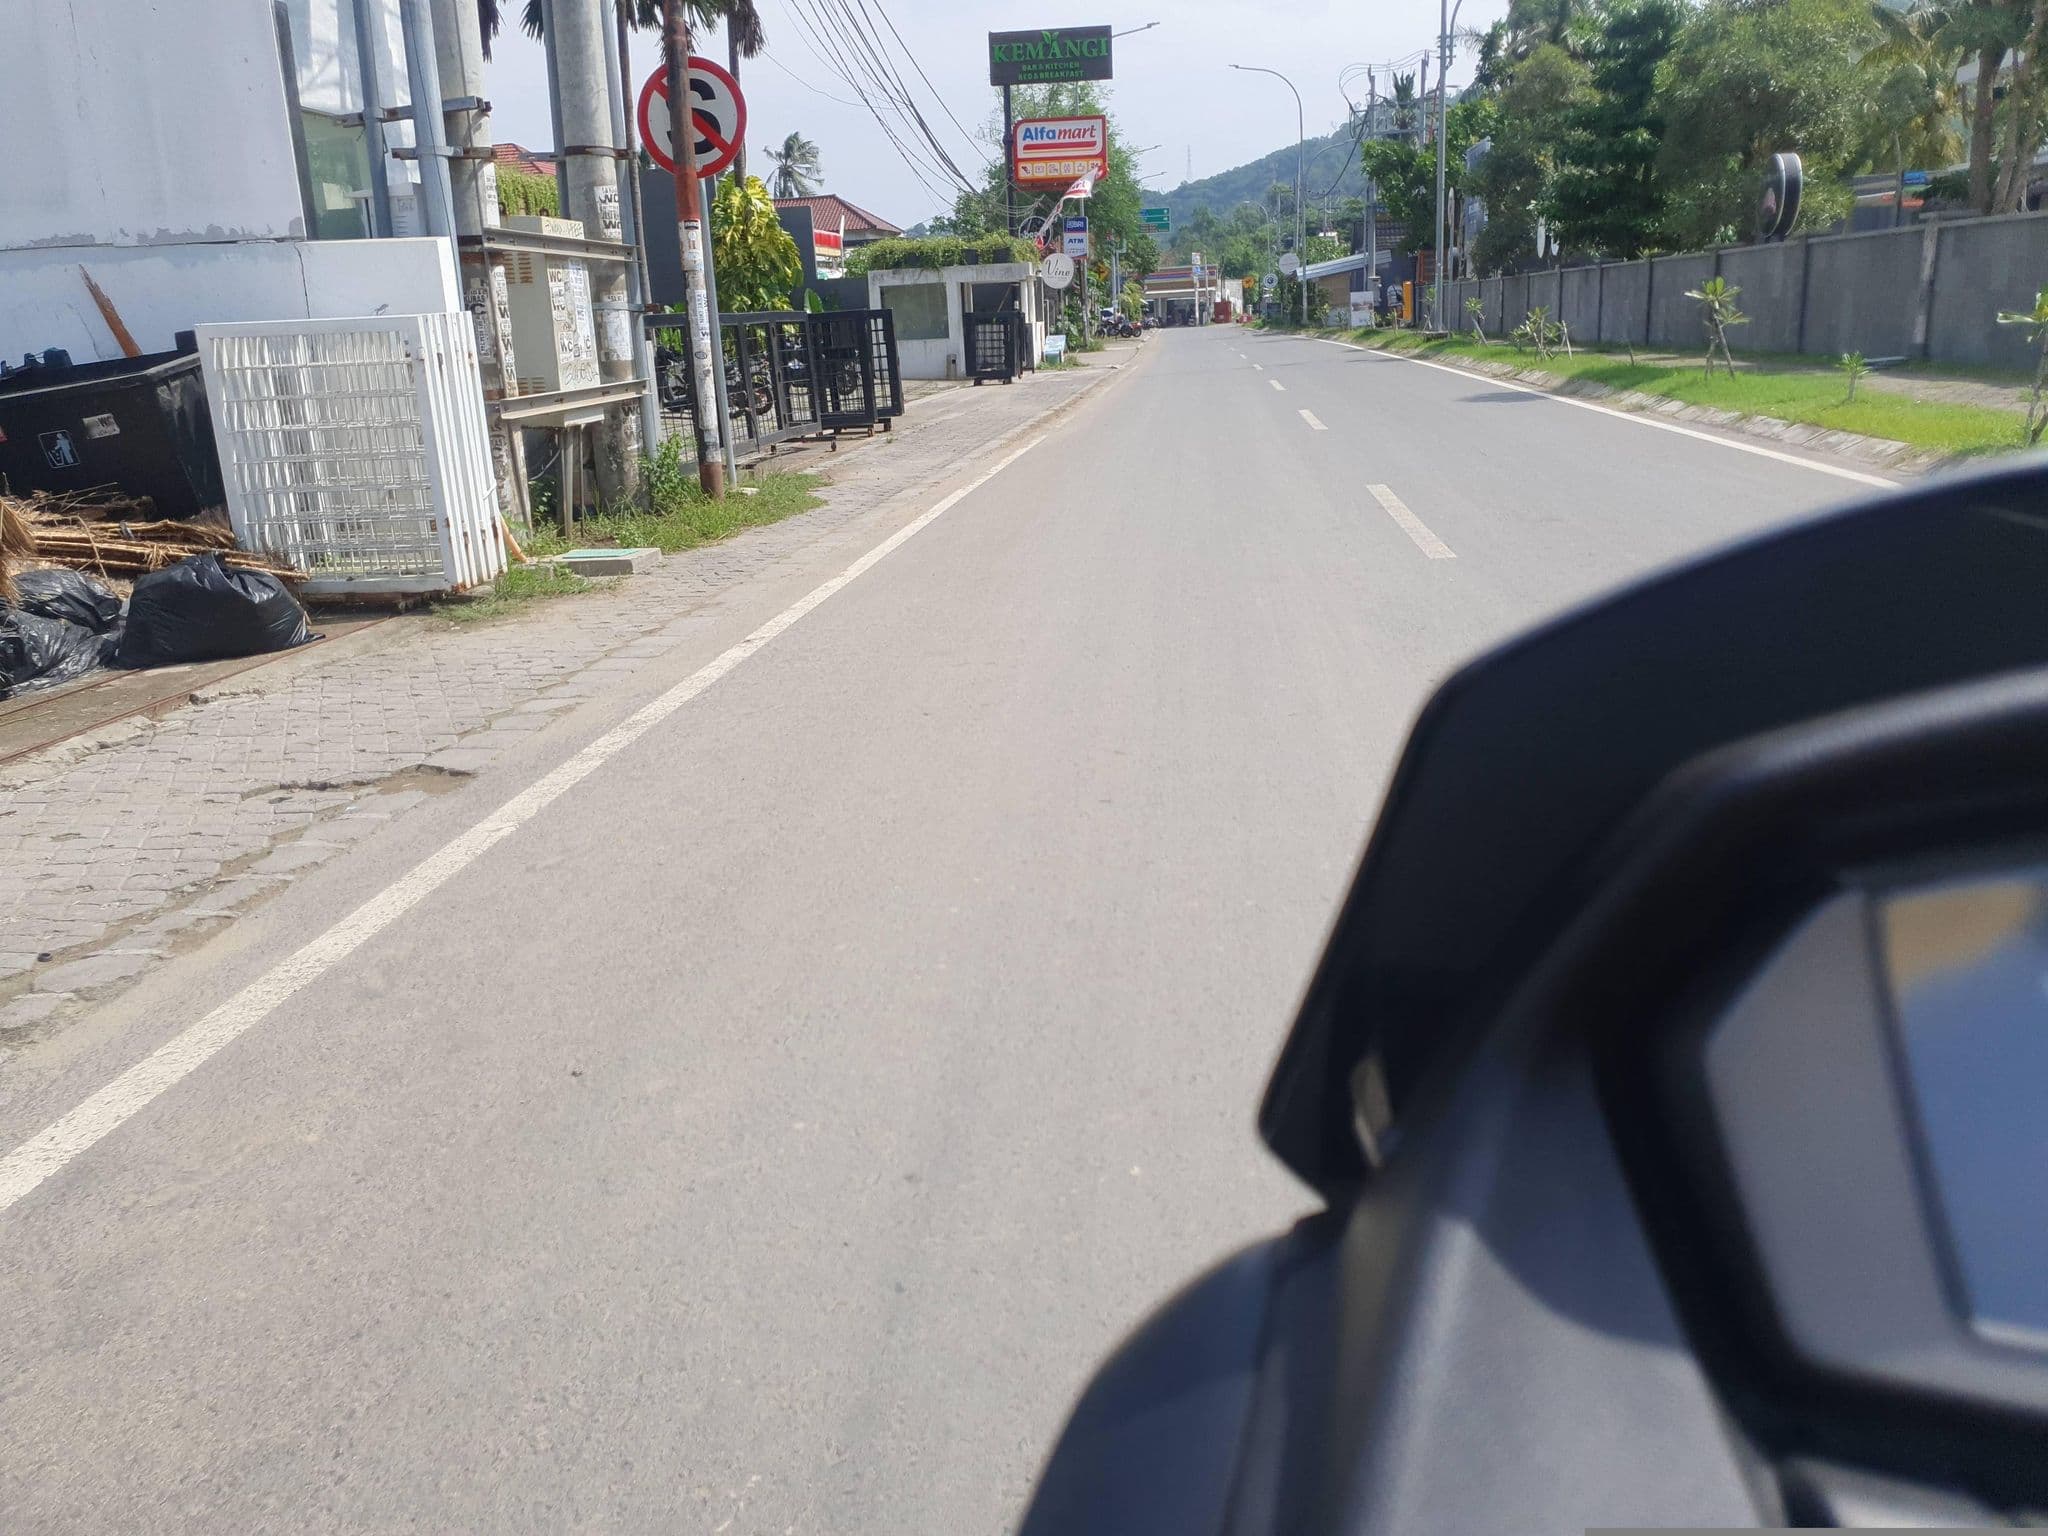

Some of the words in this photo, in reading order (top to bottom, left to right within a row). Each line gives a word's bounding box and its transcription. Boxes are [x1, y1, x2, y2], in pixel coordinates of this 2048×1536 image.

[992, 38, 1109, 63] KEMANGI
[1045, 60, 1080, 70] KITCHEN
[1039, 70, 1084, 79] BREAKFAST
[1022, 125, 1097, 141] Alfamart
[549, 270, 562, 282] WC
